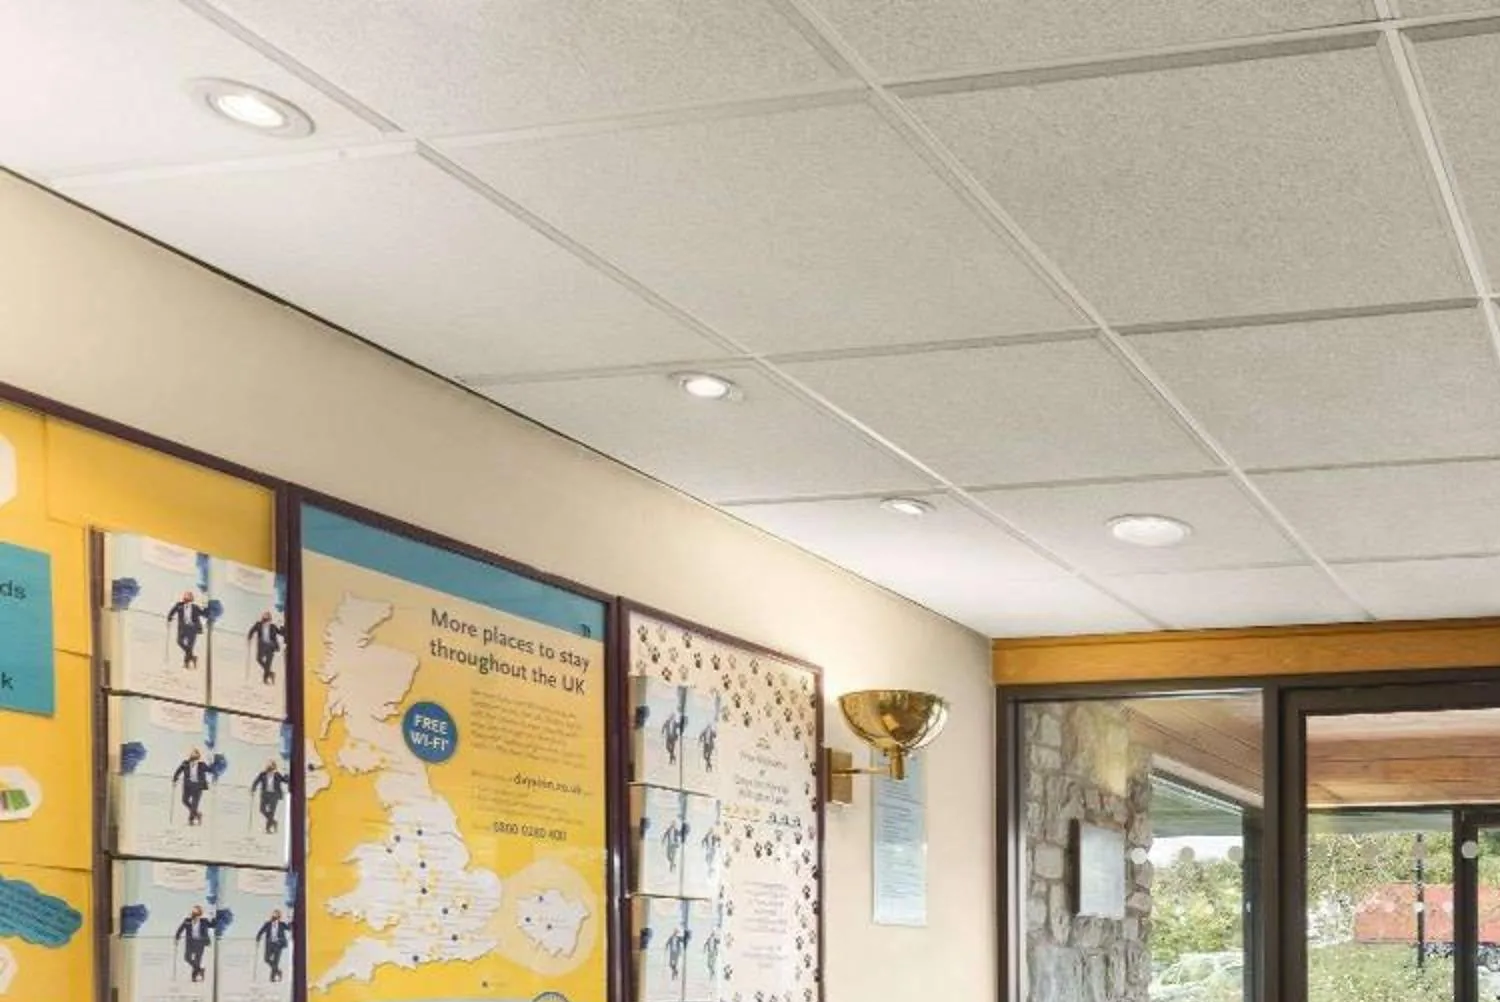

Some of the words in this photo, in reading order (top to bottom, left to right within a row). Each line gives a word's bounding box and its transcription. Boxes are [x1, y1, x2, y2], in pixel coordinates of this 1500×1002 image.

[429, 638, 527, 681] throughout
[532, 667, 556, 688] the
[562, 675, 585, 695] UK
[431, 607, 477, 637] More
[483, 626, 534, 655] places
[539, 642, 555, 659] to
[559, 650, 589, 674] stay
[414, 713, 448, 735] FREE
